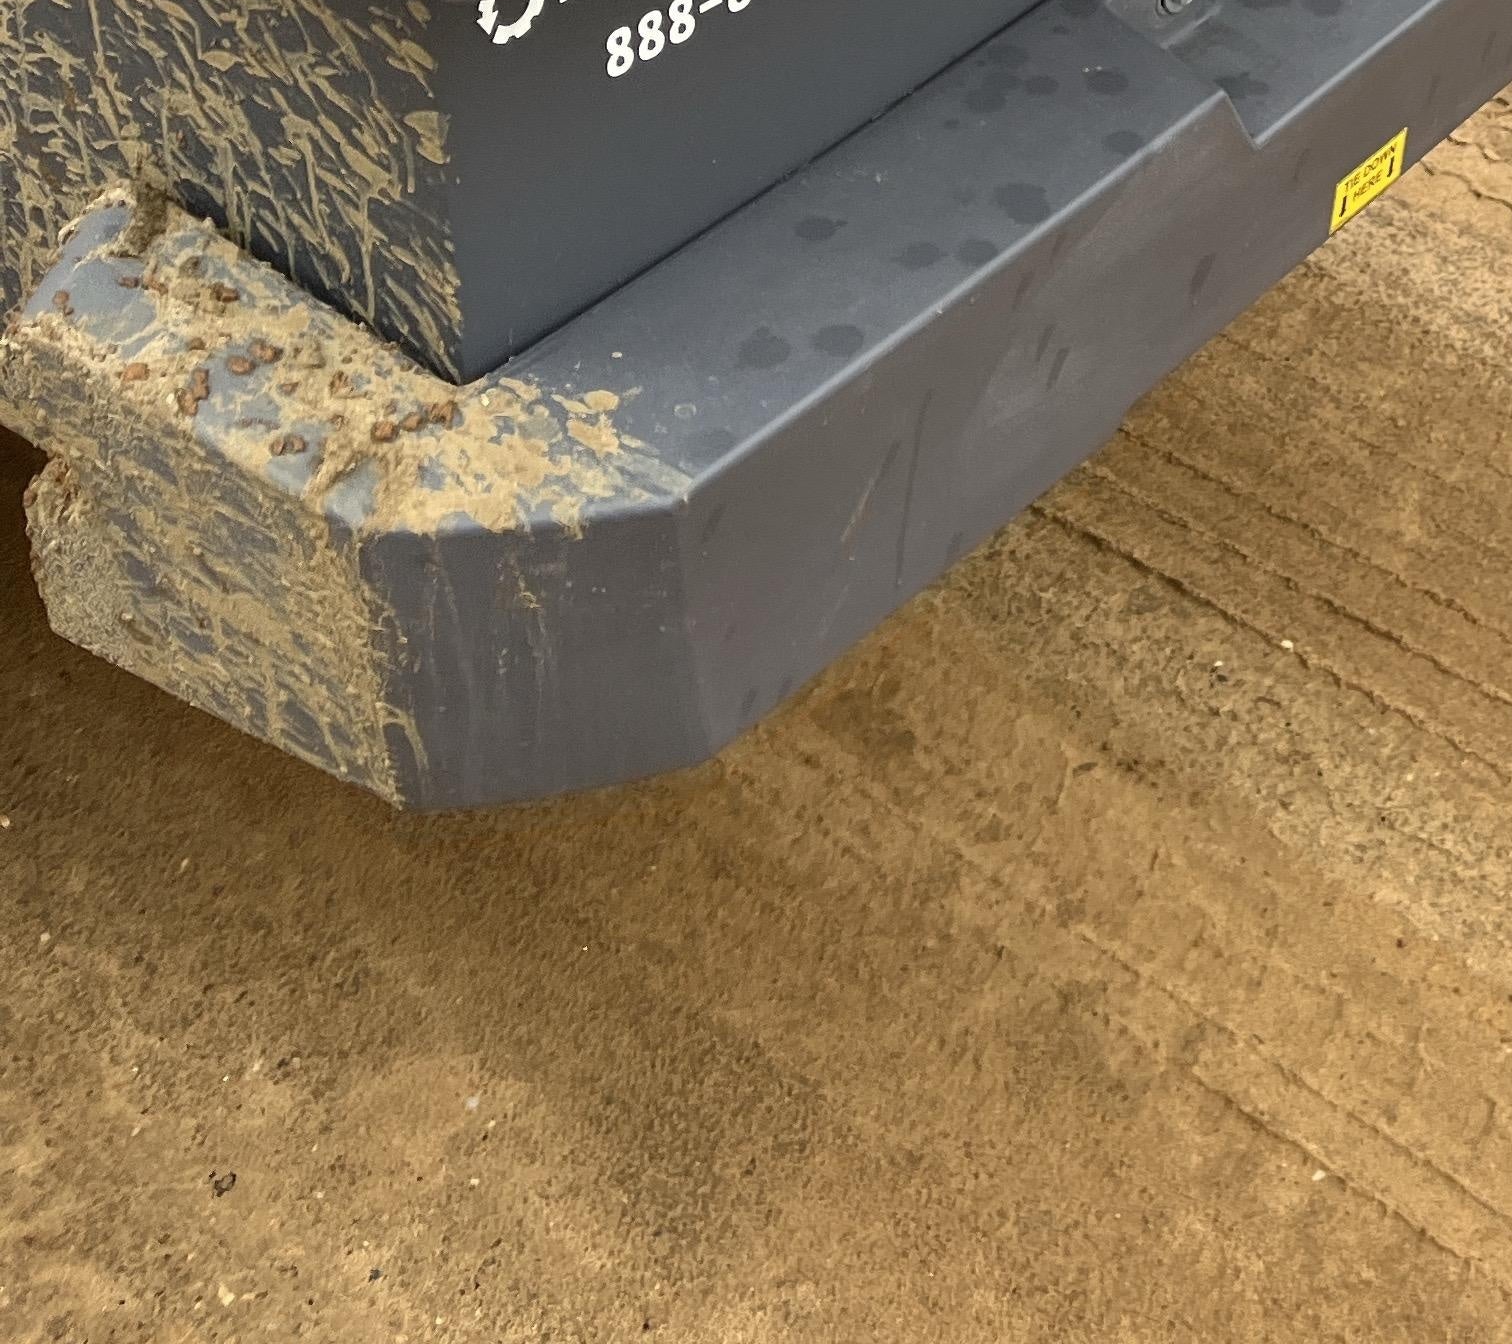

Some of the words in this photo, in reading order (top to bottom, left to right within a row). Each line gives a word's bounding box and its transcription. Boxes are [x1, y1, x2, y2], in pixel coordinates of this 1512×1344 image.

[1345, 171, 1361, 193] TIE
[1363, 141, 1398, 178] DOWN
[1353, 169, 1383, 201] HERE
